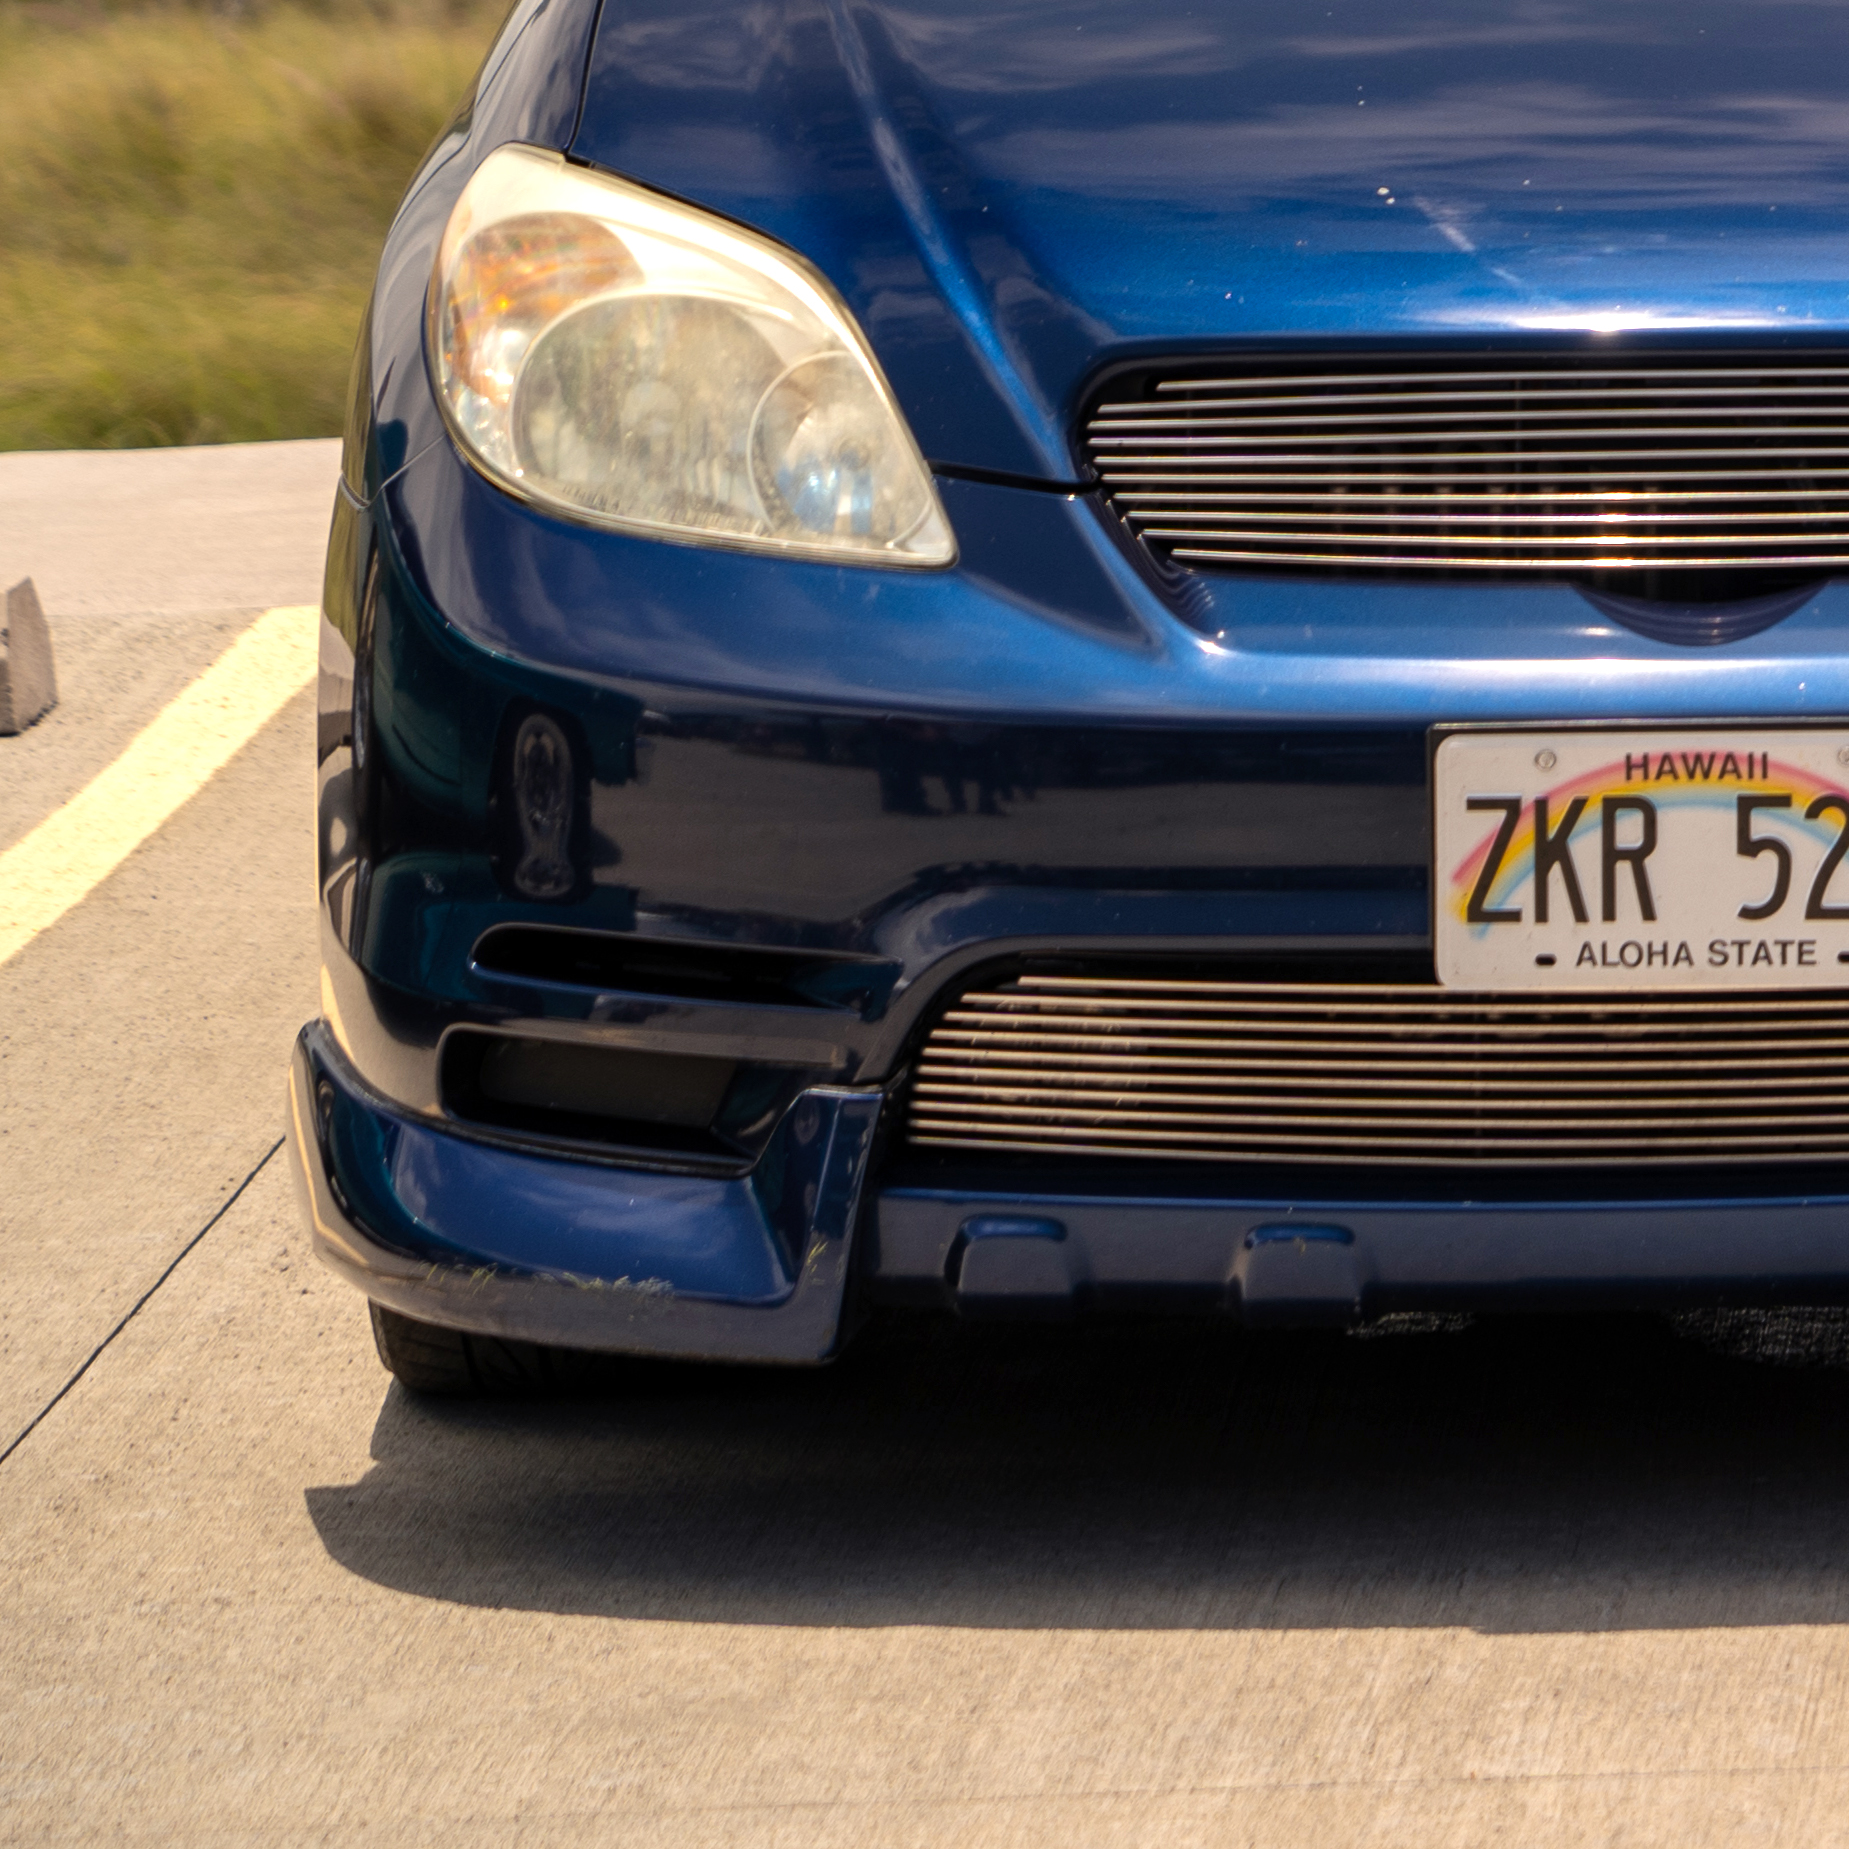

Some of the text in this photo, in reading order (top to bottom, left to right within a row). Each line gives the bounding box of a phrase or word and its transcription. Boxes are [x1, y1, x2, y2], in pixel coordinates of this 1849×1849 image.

[1625, 752, 1770, 782] HAWAII
[1466, 795, 1659, 924] ZKR
[1575, 938, 1818, 968] ALOHA STATE
